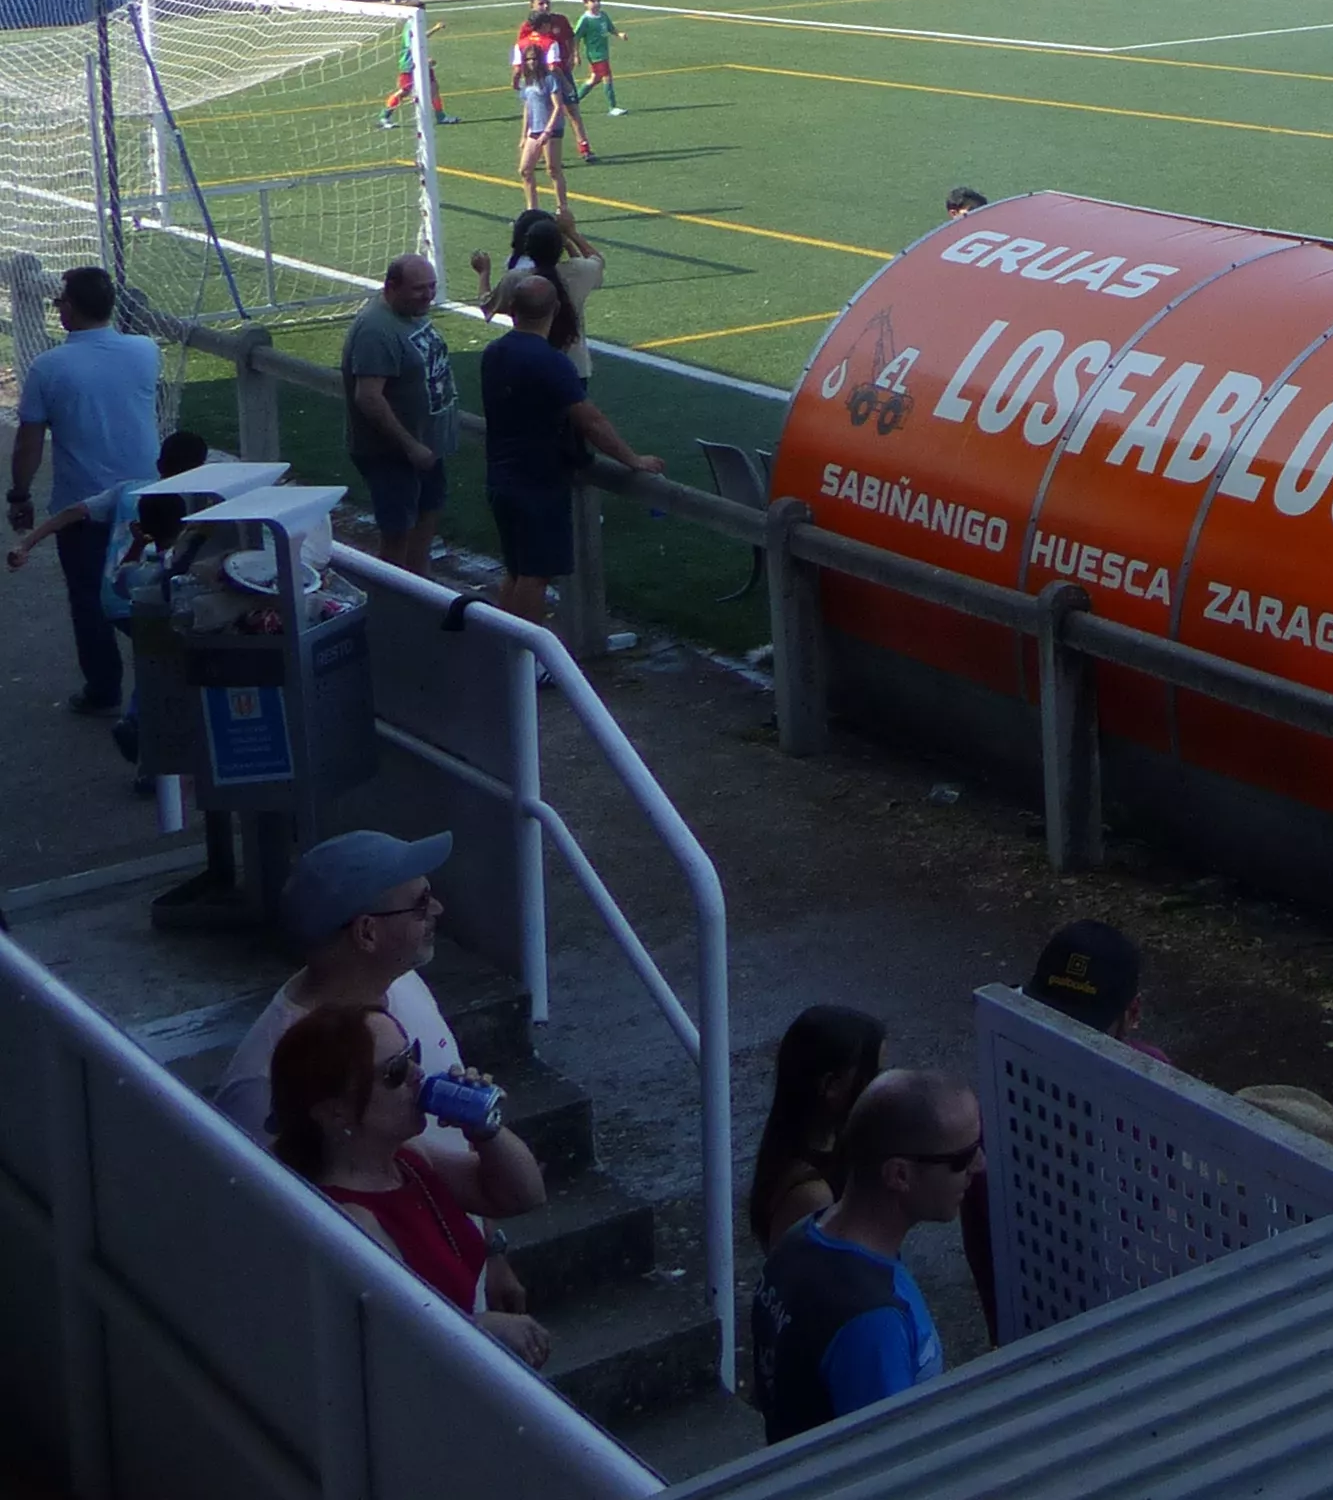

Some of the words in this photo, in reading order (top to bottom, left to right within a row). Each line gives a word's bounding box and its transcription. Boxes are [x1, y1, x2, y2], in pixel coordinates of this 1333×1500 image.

[940, 230, 1180, 299] GRUAS
[820, 461, 1009, 554] SABIÑANIGO
[1028, 529, 1171, 606] HUESCA
